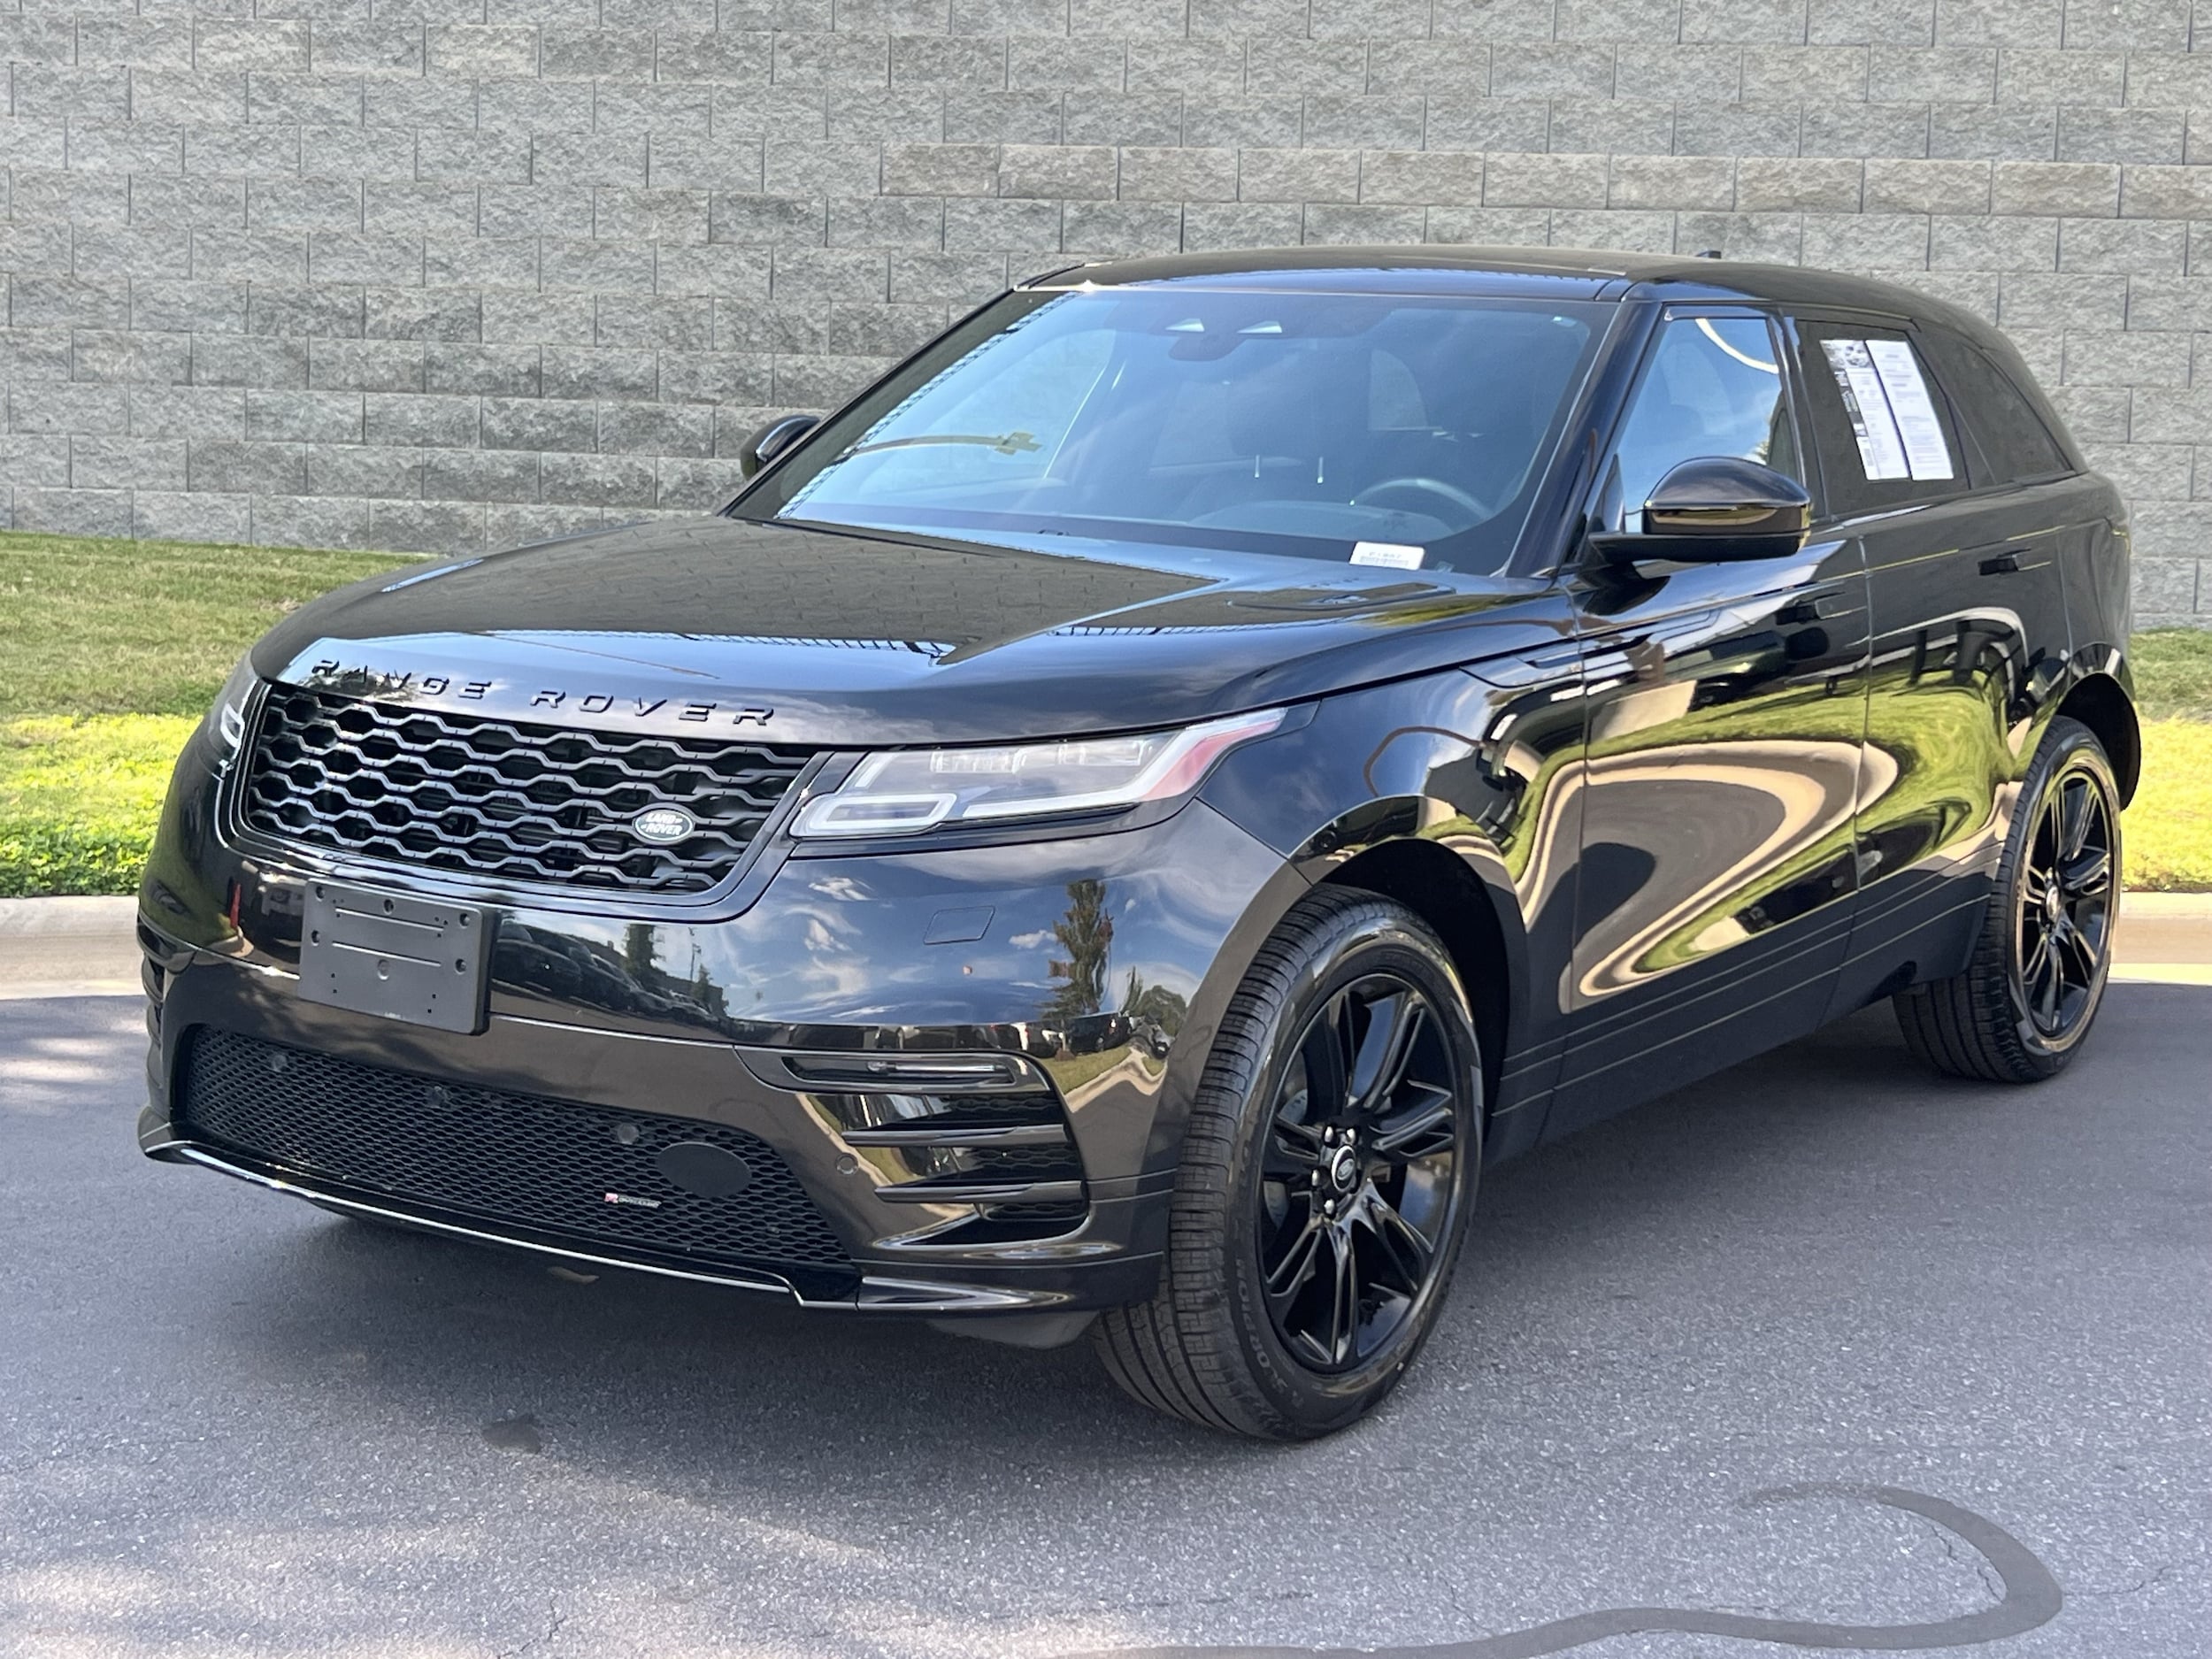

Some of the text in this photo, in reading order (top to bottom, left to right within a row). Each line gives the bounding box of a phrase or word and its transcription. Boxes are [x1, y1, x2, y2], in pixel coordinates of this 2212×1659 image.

[311, 660, 774, 726] RANGE ROVER
[646, 813, 679, 824] LAND
[644, 823, 683, 835] ROVER
